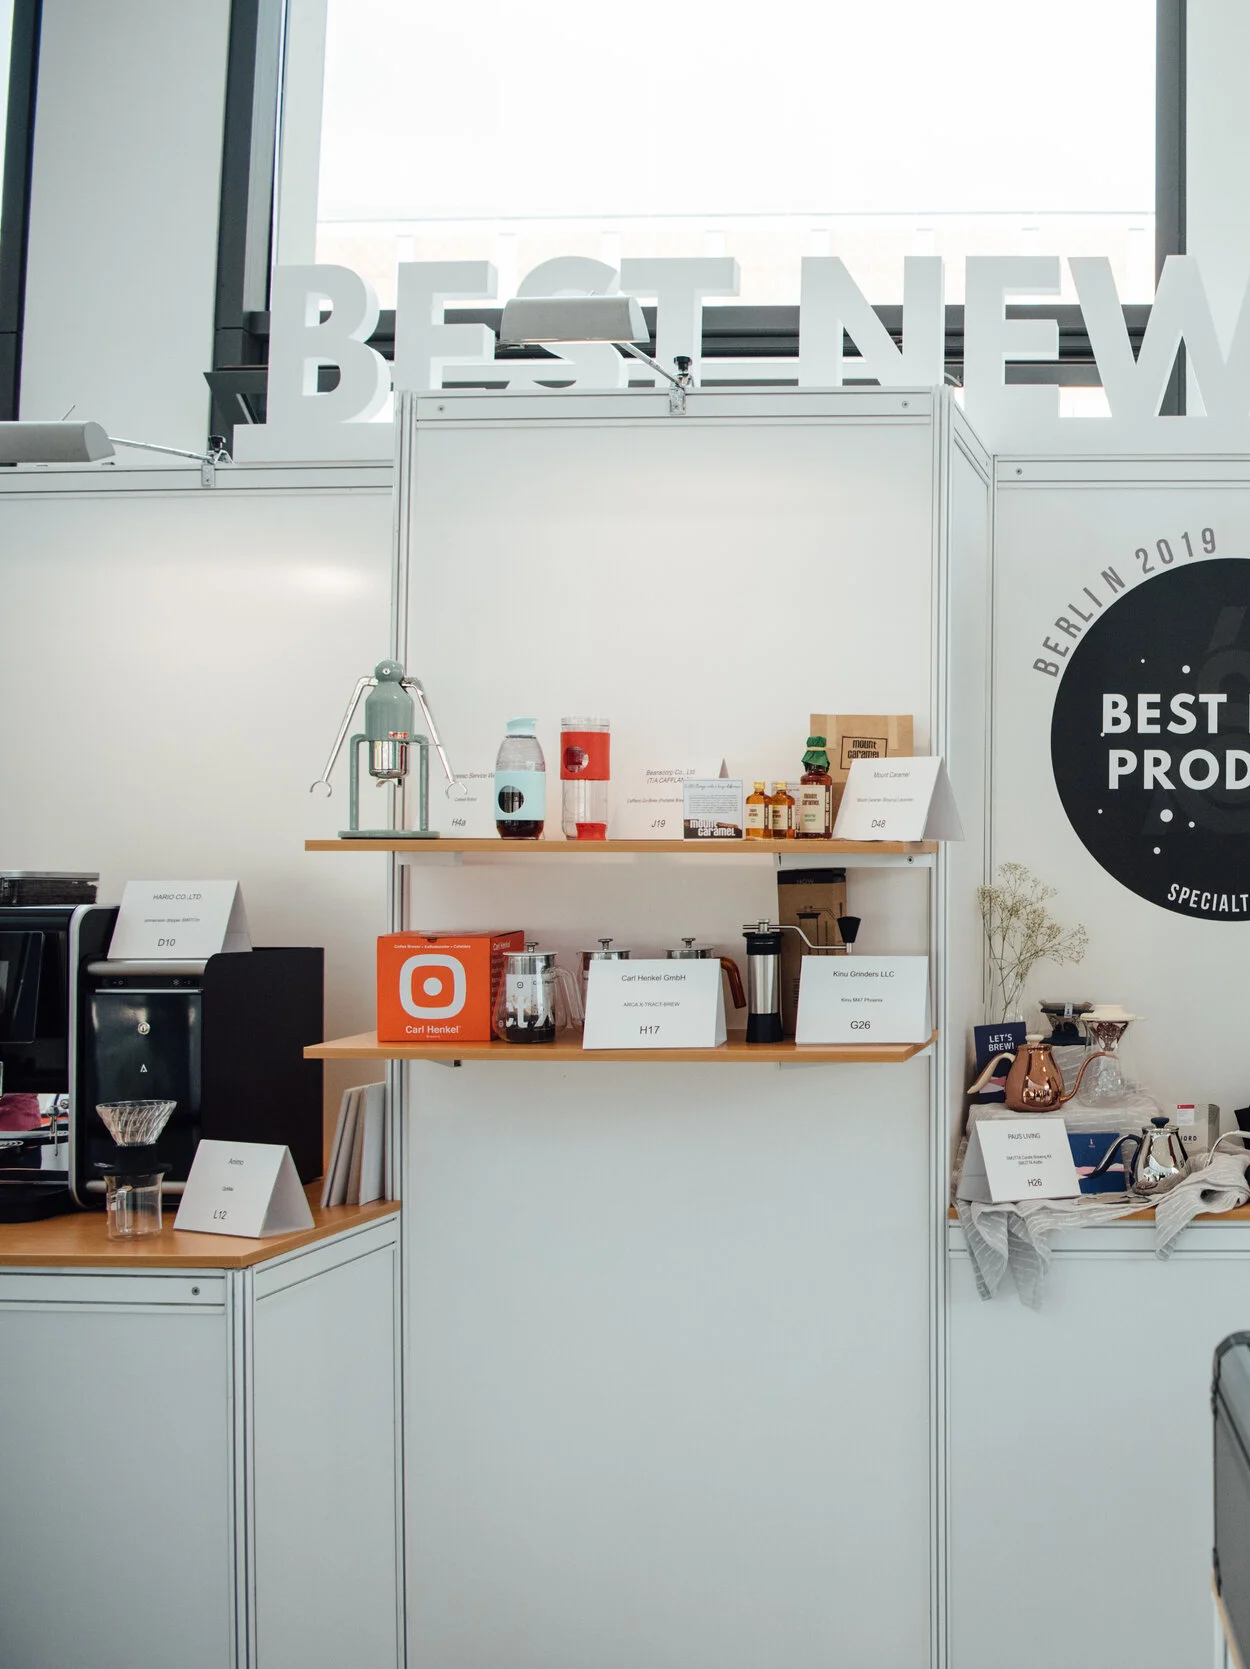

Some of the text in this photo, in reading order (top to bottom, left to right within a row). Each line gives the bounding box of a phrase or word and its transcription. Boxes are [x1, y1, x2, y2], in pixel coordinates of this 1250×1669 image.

[266, 256, 742, 422] BEST
[1032, 527, 1216, 678] BERLIN 2019
[1102, 692, 1227, 734] BEST
[852, 739, 877, 750] mount
[847, 750, 880, 759] caramel
[651, 819, 666, 828] J19
[871, 819, 886, 828] D48
[698, 827, 736, 837] caramel
[157, 938, 176, 947] D10
[621, 974, 687, 982] Carl Henkel GmbH
[832, 970, 895, 978] Kinu Grinders LLC
[405, 1025, 459, 1034] Carl Henkel
[850, 1020, 871, 1030] G26
[639, 1026, 660, 1035] H17
[989, 1033, 1013, 1043] LET'S
[988, 1042, 1015, 1052] BREW!
[1023, 1132, 1041, 1140] LIVING
[1027, 1178, 1043, 1187] H26
[213, 1209, 228, 1220] L12
